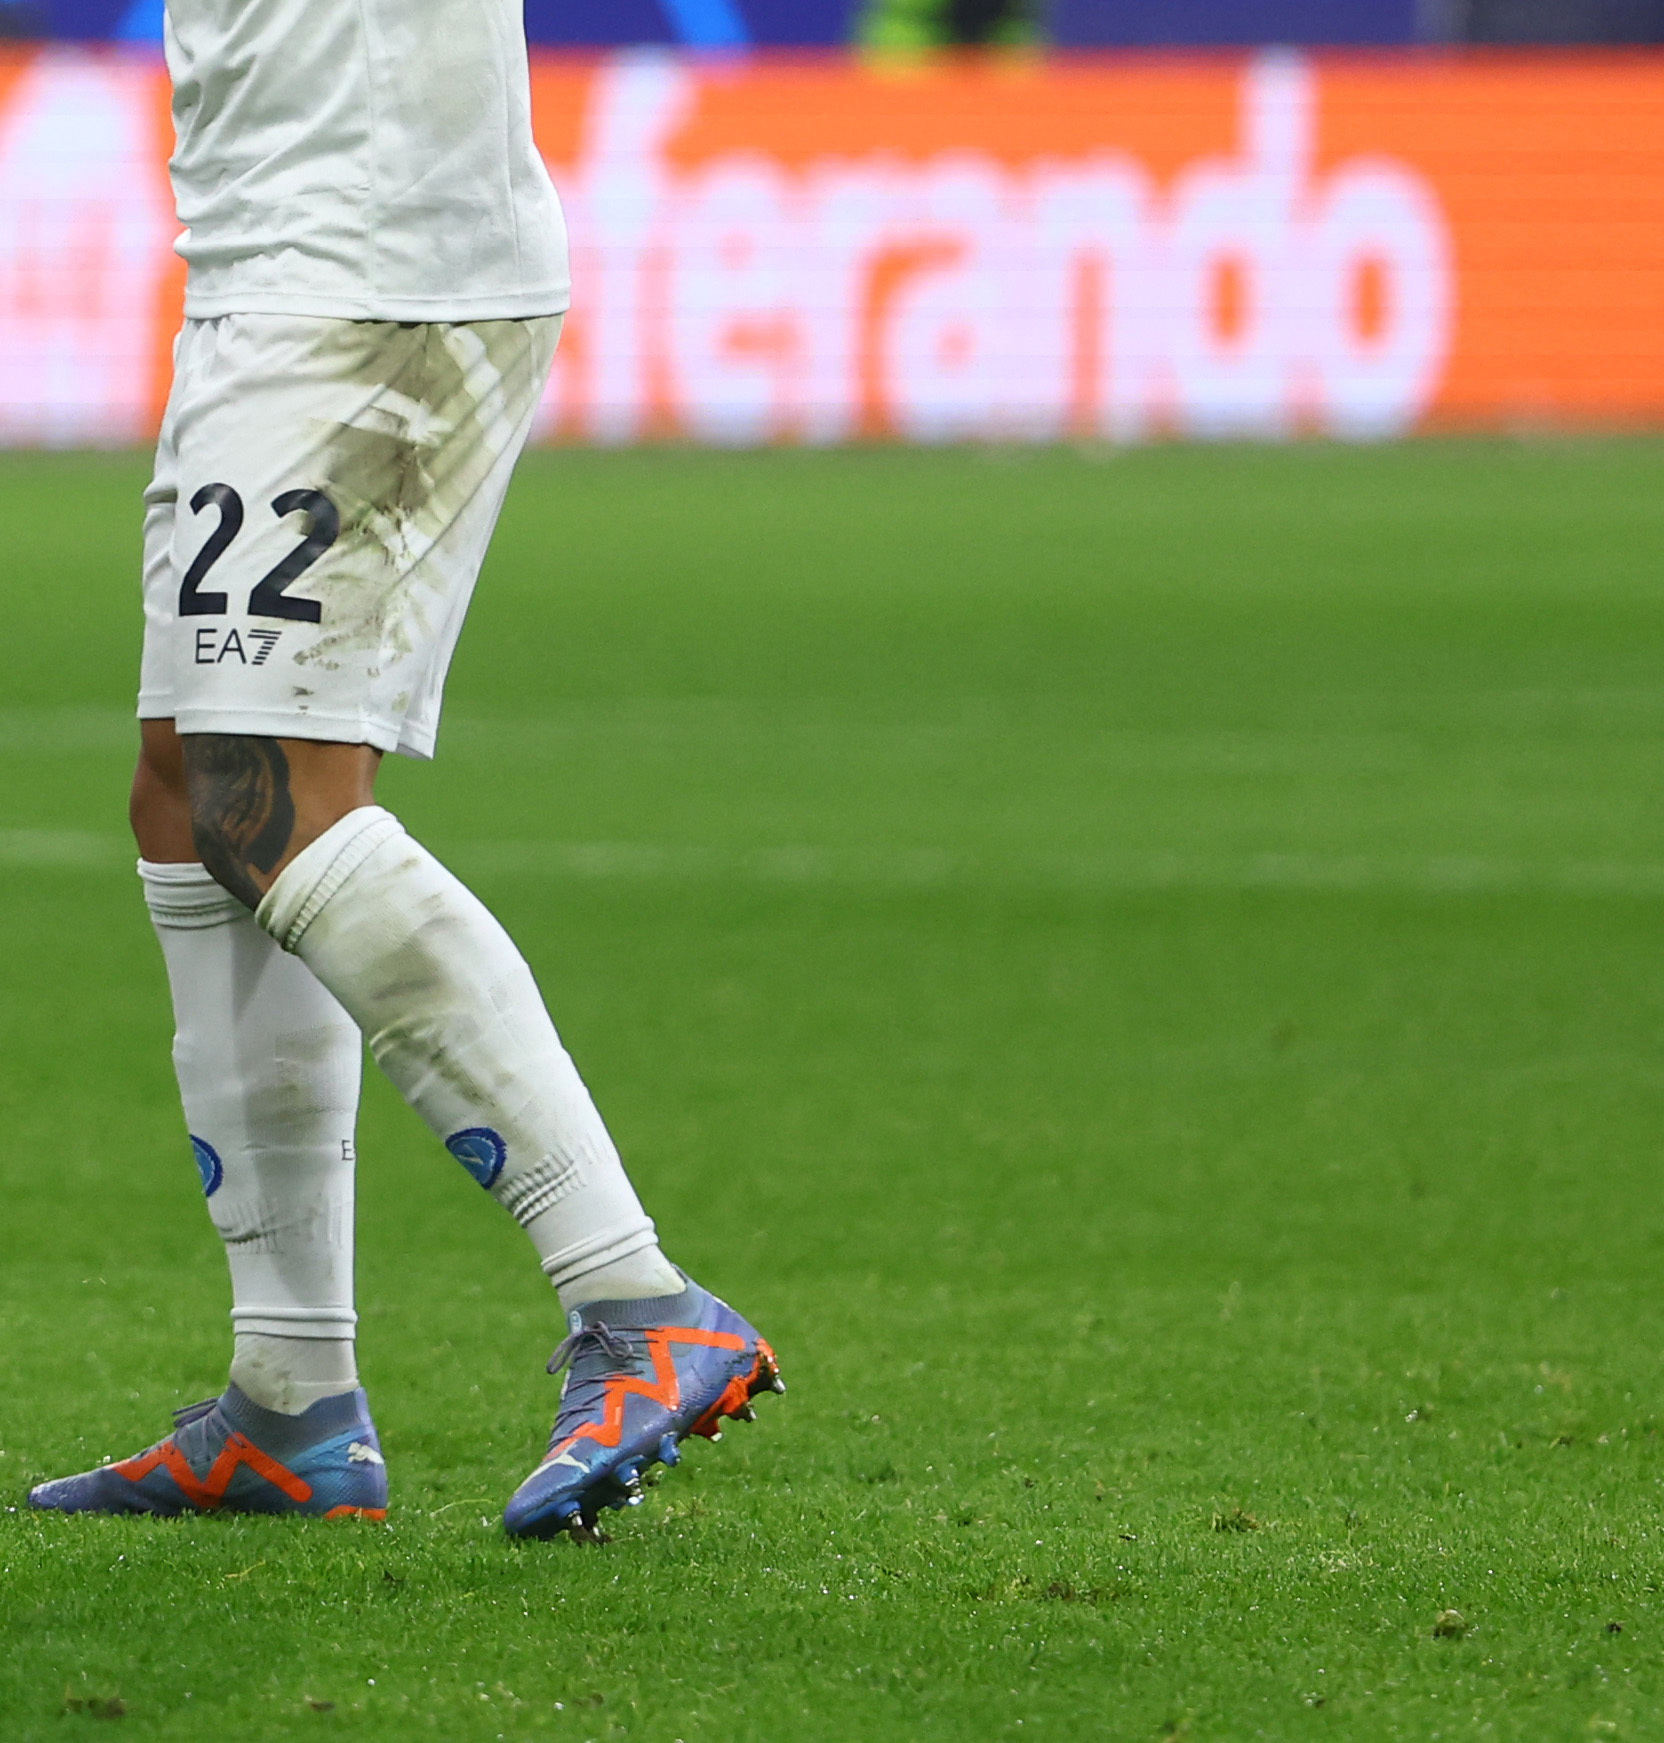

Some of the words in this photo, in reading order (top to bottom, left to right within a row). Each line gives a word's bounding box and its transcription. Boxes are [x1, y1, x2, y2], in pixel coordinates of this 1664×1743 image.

[534, 47, 1452, 446] ferando
[178, 482, 340, 624] 22
[195, 628, 282, 666] EA7
